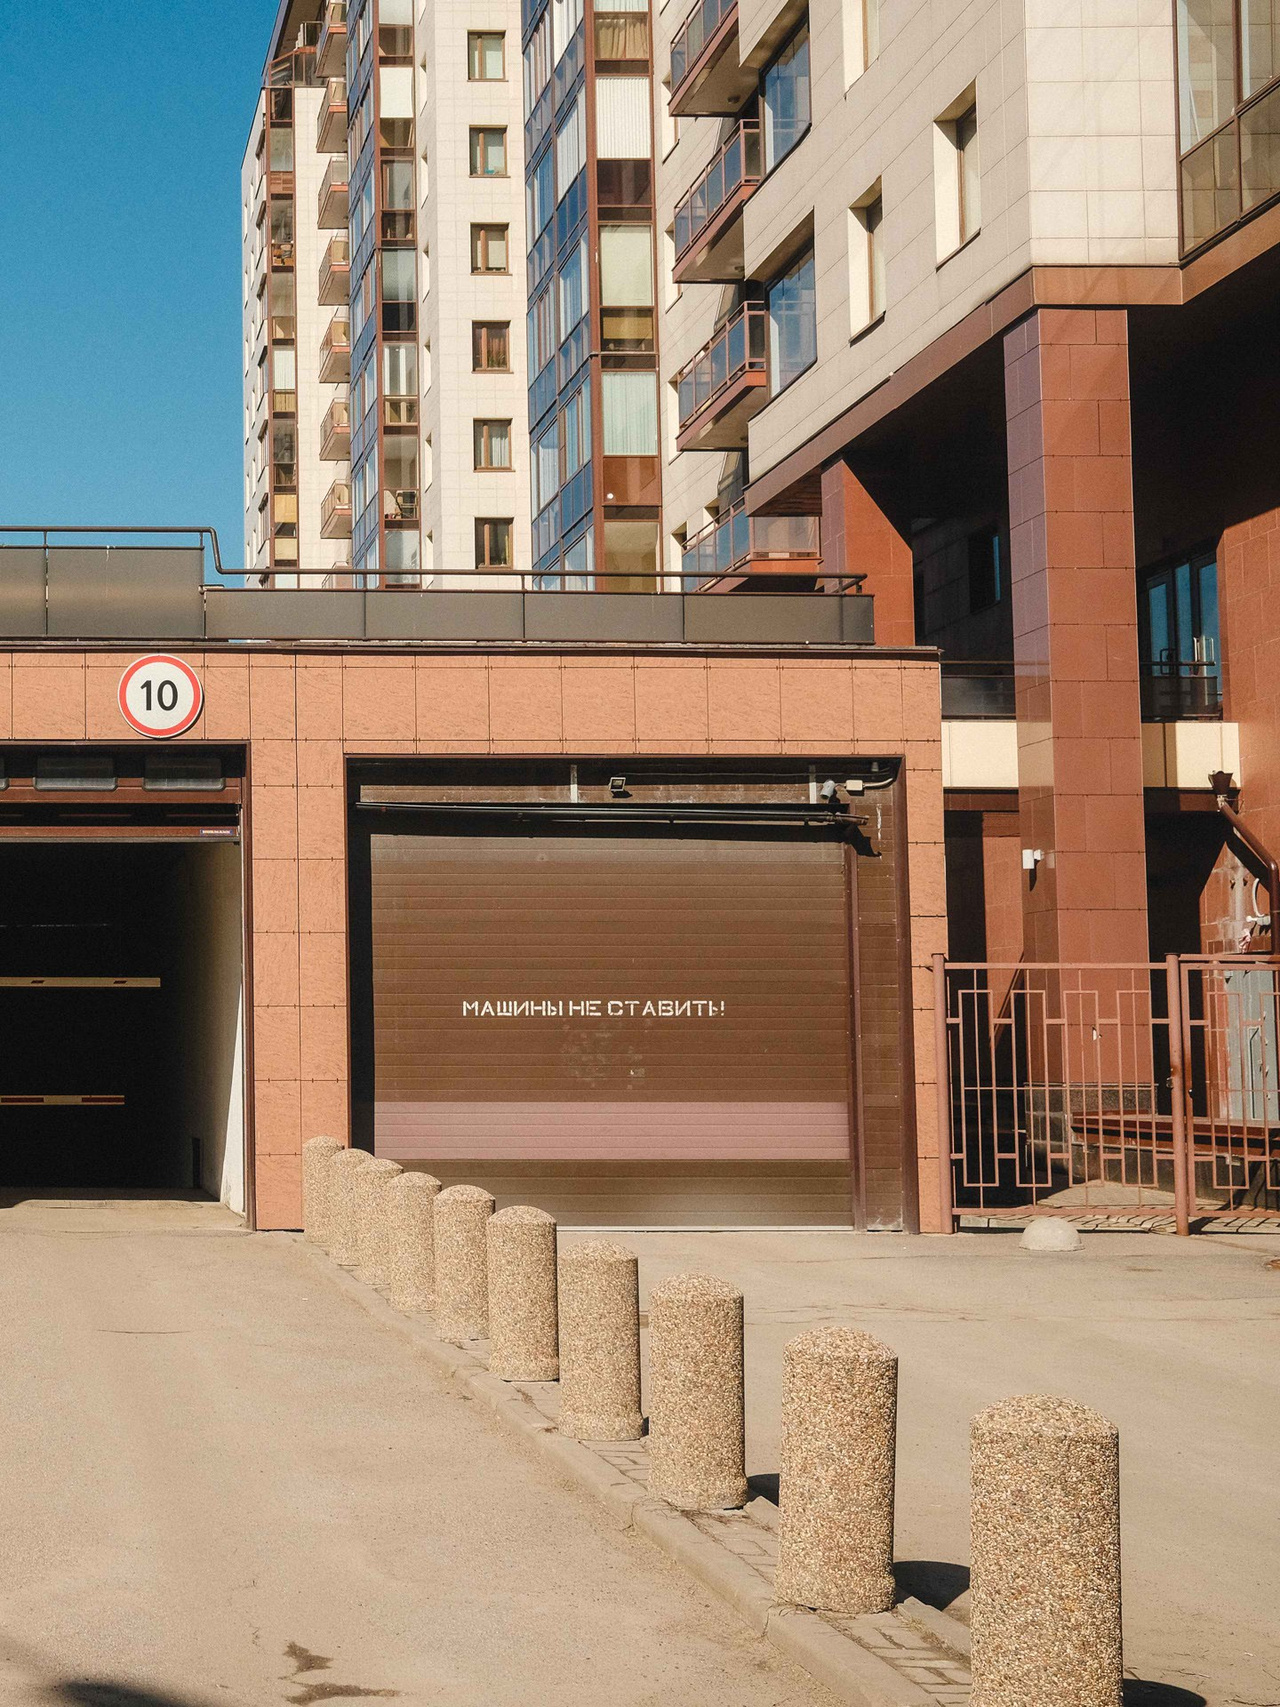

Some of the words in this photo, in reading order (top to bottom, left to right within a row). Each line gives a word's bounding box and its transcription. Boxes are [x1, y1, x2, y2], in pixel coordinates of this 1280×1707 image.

[140, 680, 179, 712] 10
[462, 1000, 563, 1017] МАШИНЫ
[568, 1000, 602, 1017] НЕ
